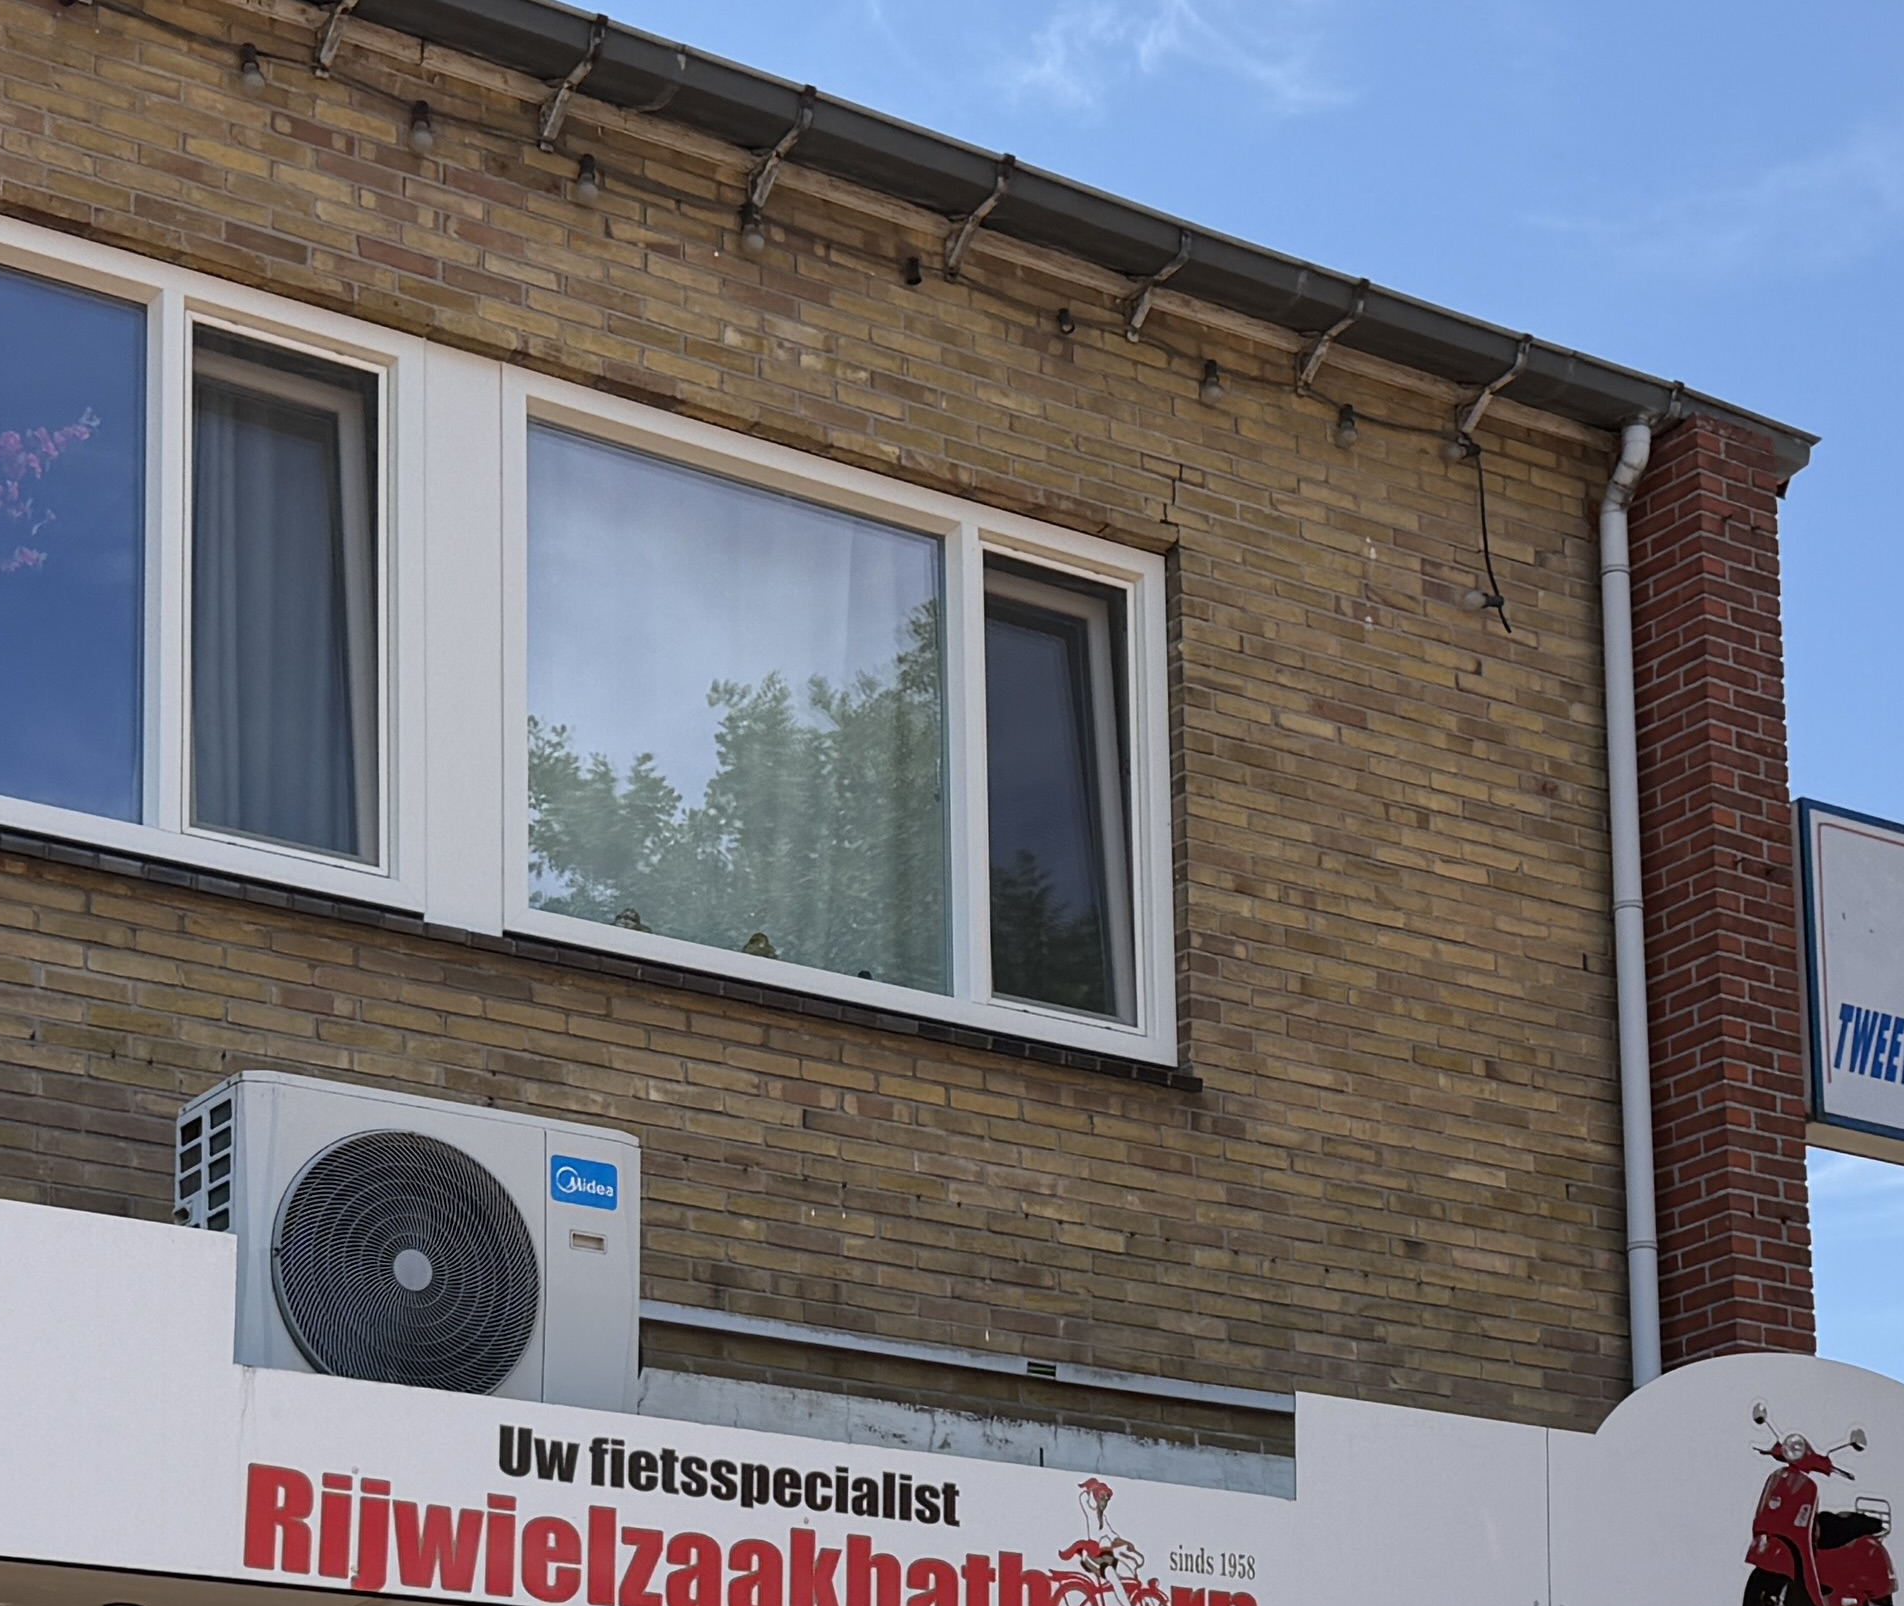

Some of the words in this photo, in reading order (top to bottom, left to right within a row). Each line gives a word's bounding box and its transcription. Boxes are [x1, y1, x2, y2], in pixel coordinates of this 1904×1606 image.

[555, 1165, 614, 1198] Midea
[498, 1424, 581, 1483] Uw
[589, 1437, 960, 1528] fietsspecialist
[1170, 1544, 1215, 1575] sinds
[1219, 1552, 1256, 1580] 1958
